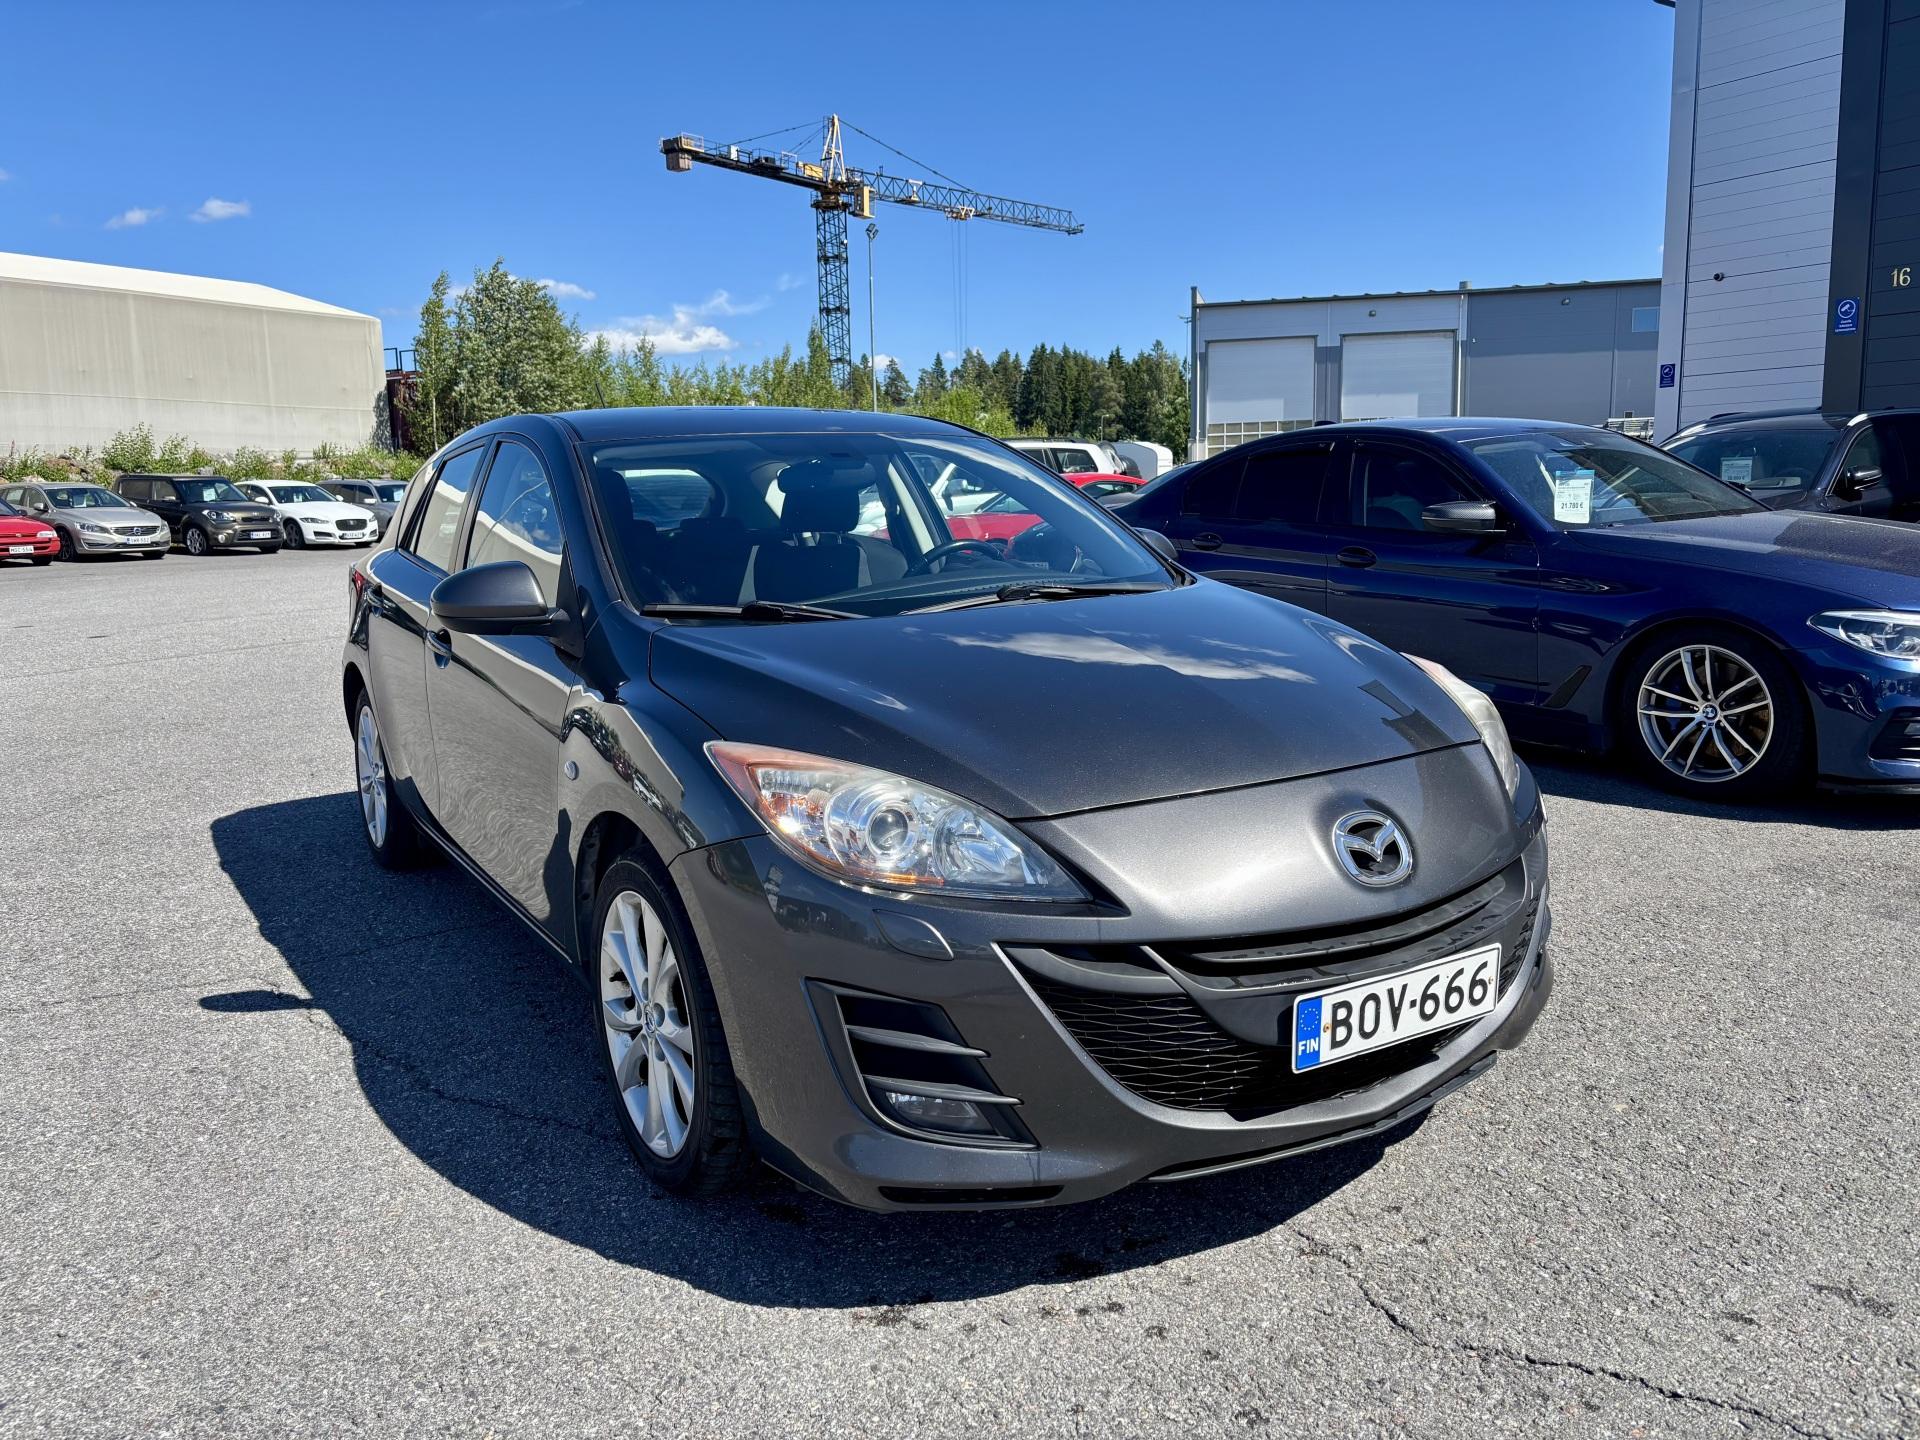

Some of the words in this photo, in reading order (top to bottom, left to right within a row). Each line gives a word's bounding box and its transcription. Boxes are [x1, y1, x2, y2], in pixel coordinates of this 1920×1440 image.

[1890, 267, 1911, 287] 16
[1330, 960, 1489, 1050] BOV-666
[1298, 1037, 1319, 1056] FIN
